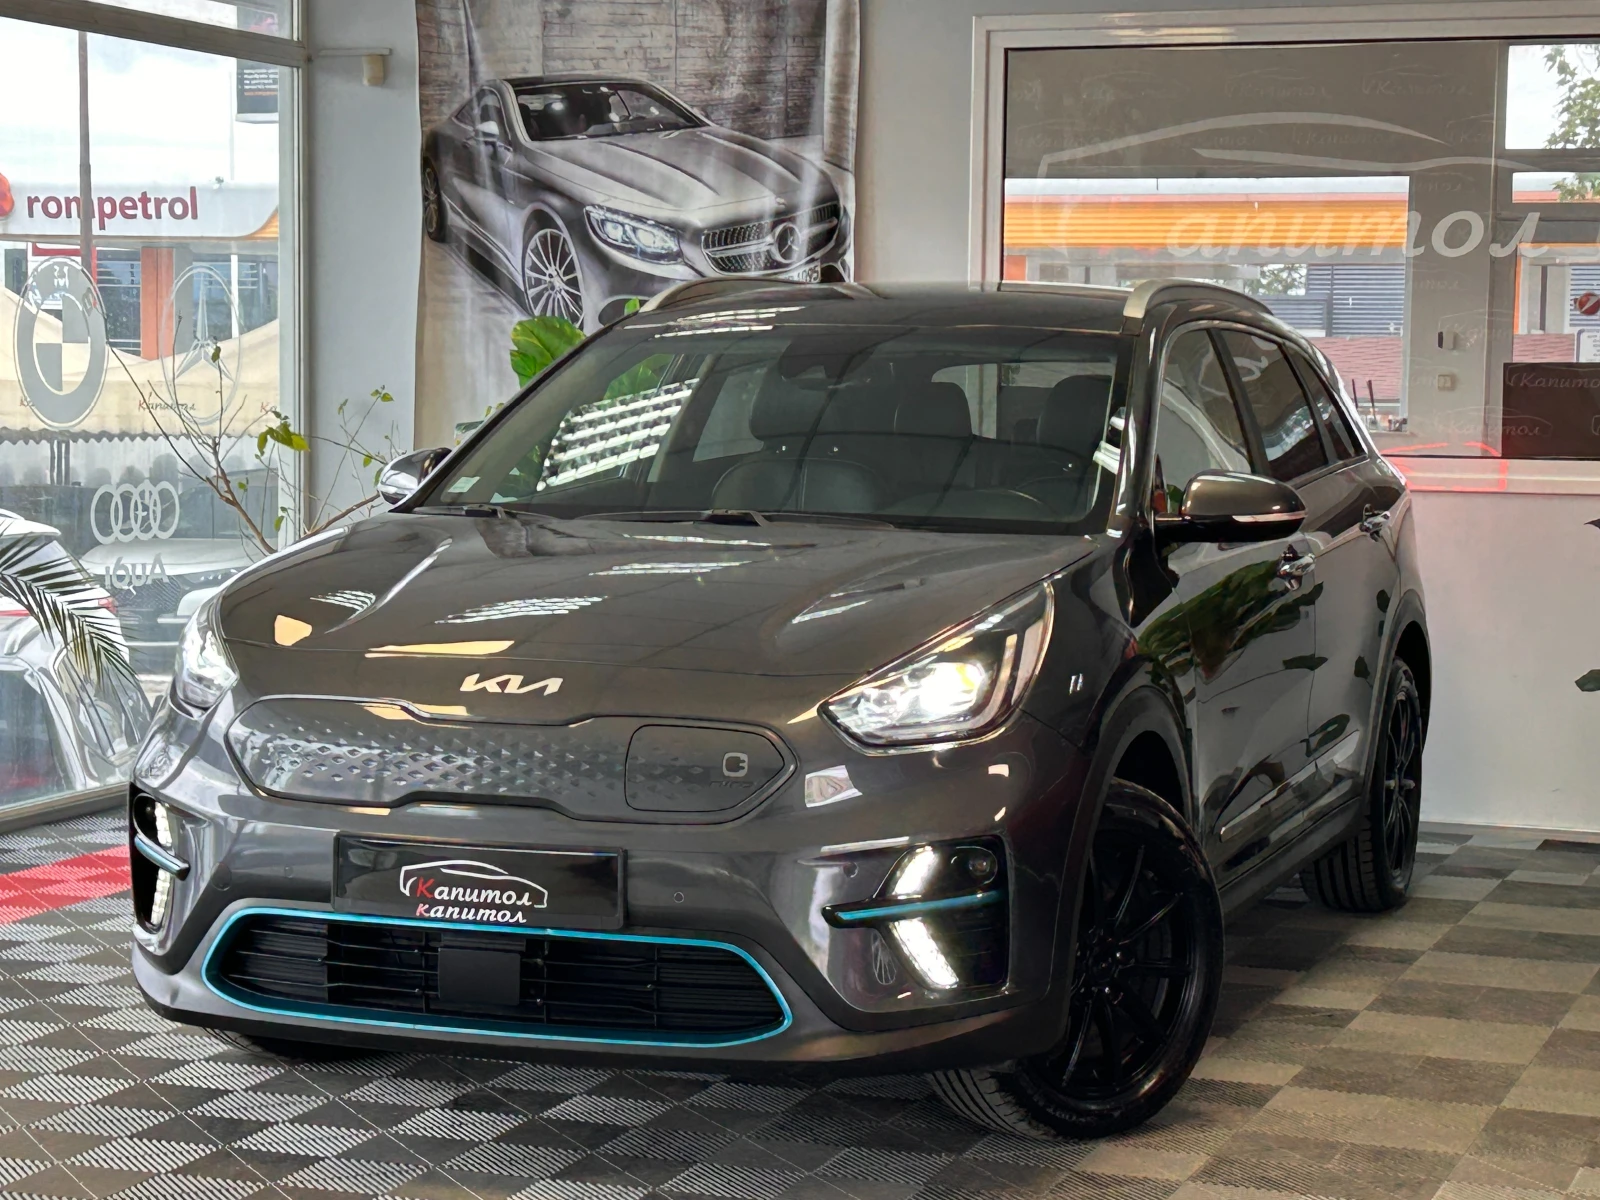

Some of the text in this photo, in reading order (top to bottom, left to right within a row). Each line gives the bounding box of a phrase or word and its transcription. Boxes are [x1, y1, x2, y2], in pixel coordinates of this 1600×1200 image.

[27, 186, 198, 231] rompetrol
[1100, 197, 1551, 258] апитол
[1519, 372, 1600, 389] Капито
[459, 673, 564, 696] KIA
[416, 876, 533, 907] Капитол
